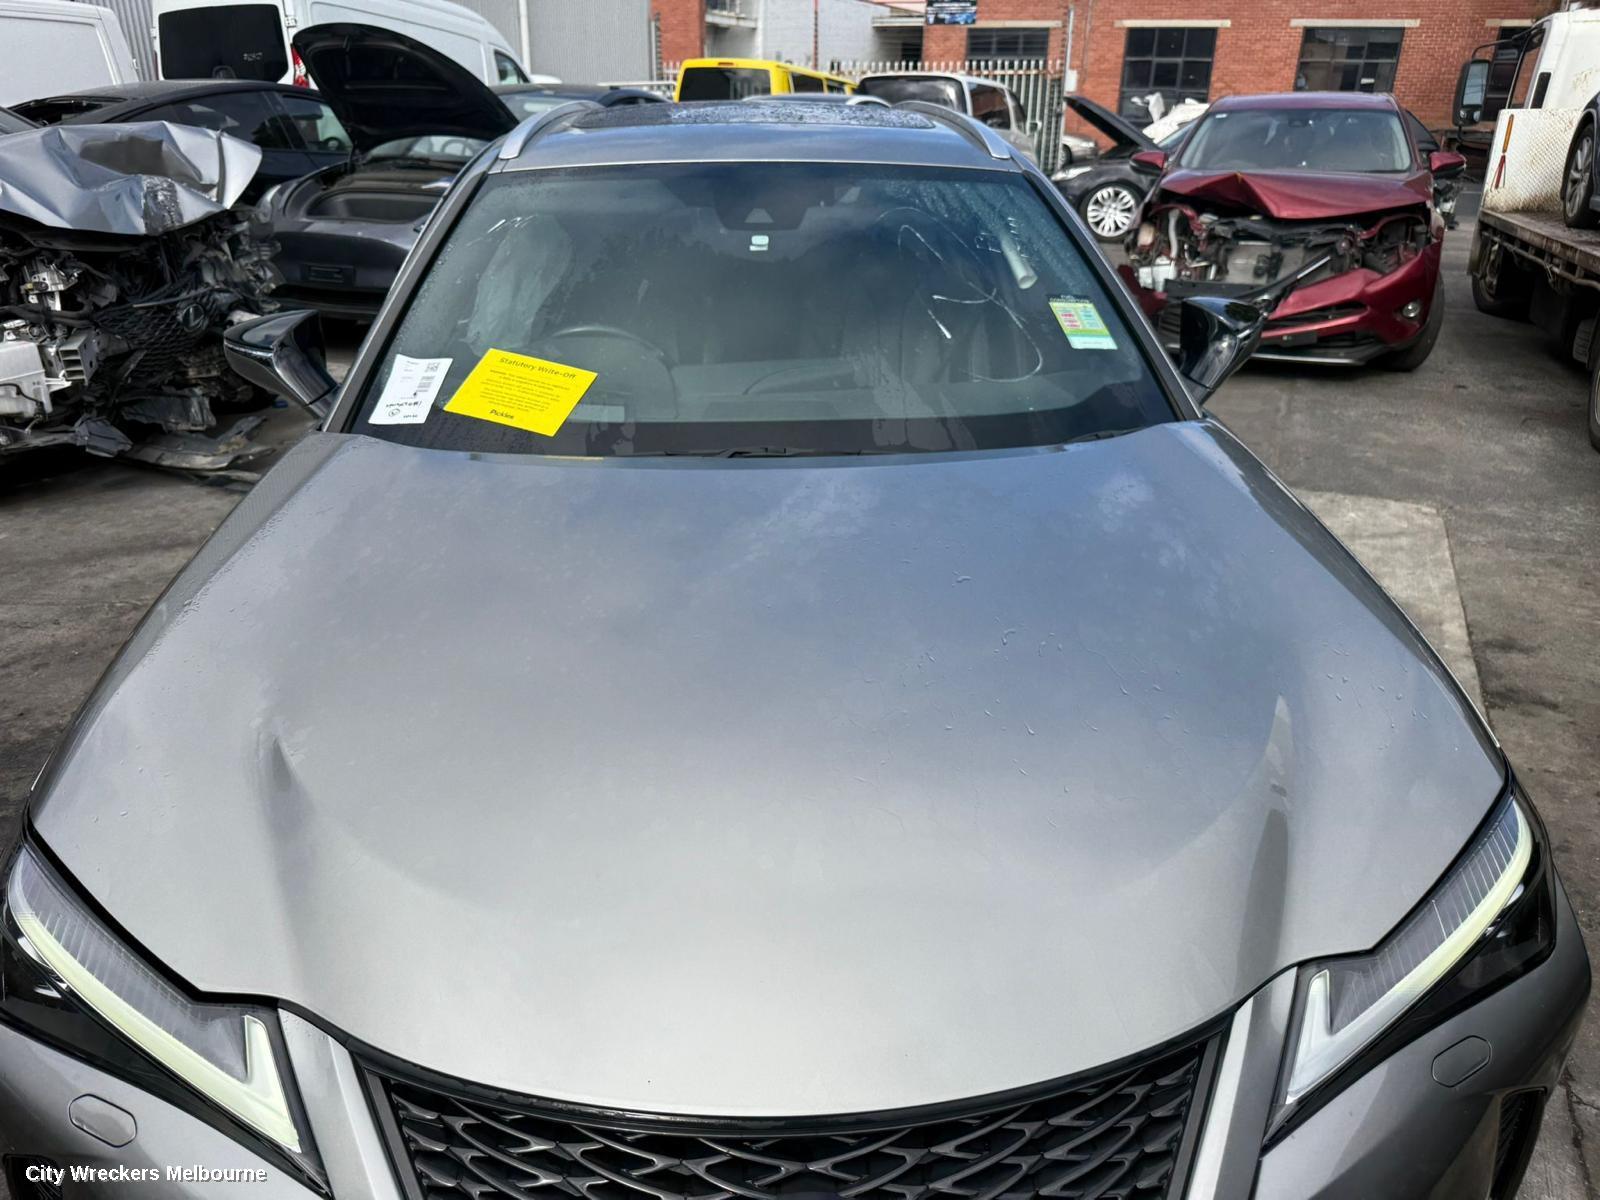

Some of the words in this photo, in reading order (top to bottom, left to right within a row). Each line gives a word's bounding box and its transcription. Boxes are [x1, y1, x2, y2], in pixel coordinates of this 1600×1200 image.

[500, 357, 535, 372] Statutory
[538, 365, 576, 379] Write-Off
[490, 409, 514, 420] Pickles
